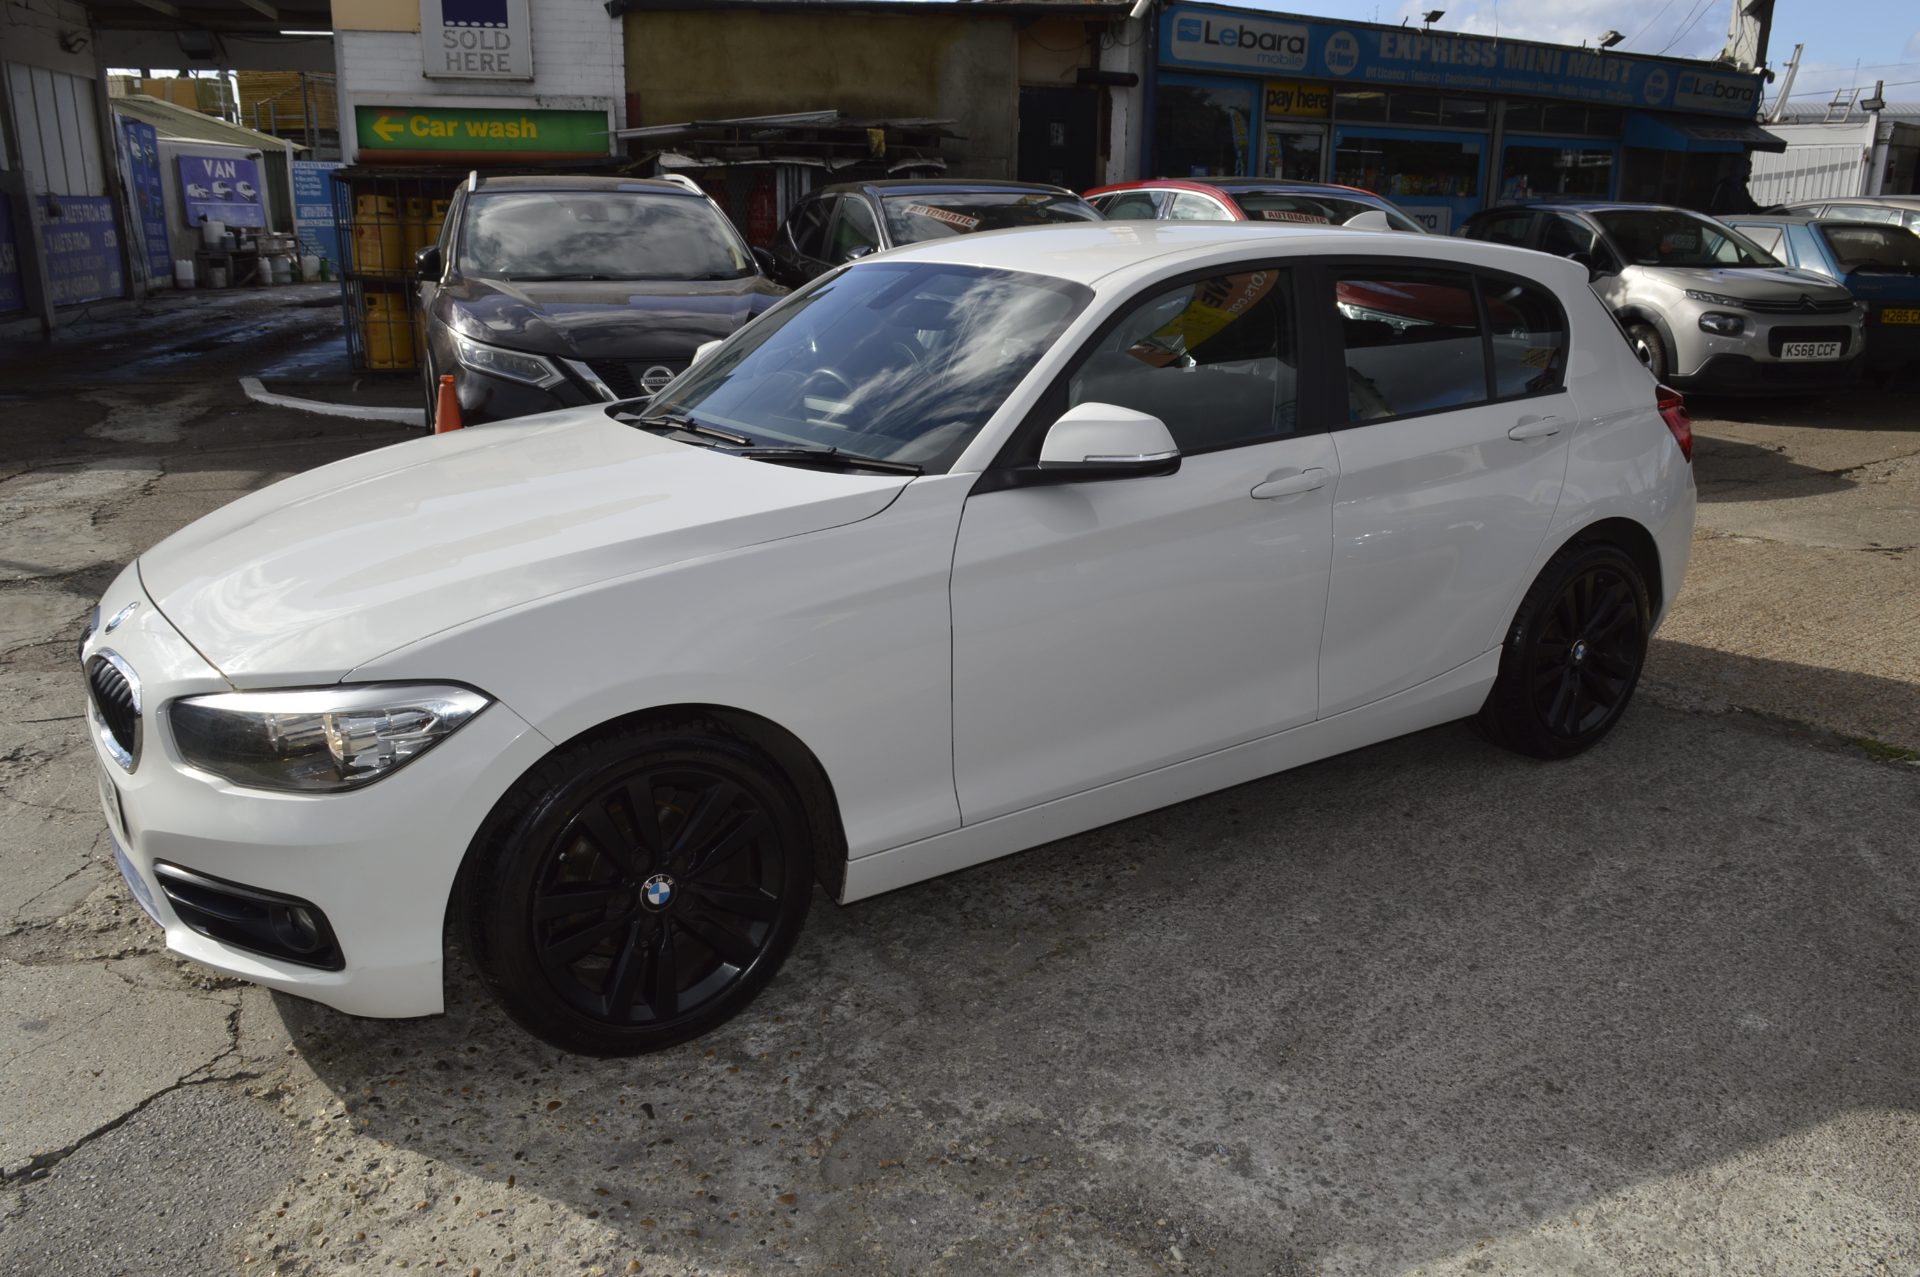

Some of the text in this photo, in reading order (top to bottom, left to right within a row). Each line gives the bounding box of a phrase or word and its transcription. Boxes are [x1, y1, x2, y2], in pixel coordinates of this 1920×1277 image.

[443, 29, 512, 51] SOLD
[1204, 20, 1305, 54] Lebara
[445, 51, 512, 73] HERE
[1257, 53, 1303, 66] mobile
[1379, 31, 1636, 84] EXPRESS MINI MART
[1265, 85, 1330, 112] pay here
[1692, 77, 1754, 101] Lebara
[409, 115, 538, 139] Car wash
[203, 159, 236, 178] VAN
[293, 161, 320, 169] EXPRESS
[910, 205, 975, 226] AUTOMATIC
[1268, 210, 1328, 225] AUTOMATIC
[1882, 310, 1909, 323] H285
[1786, 343, 1838, 358] KS68 CCF
